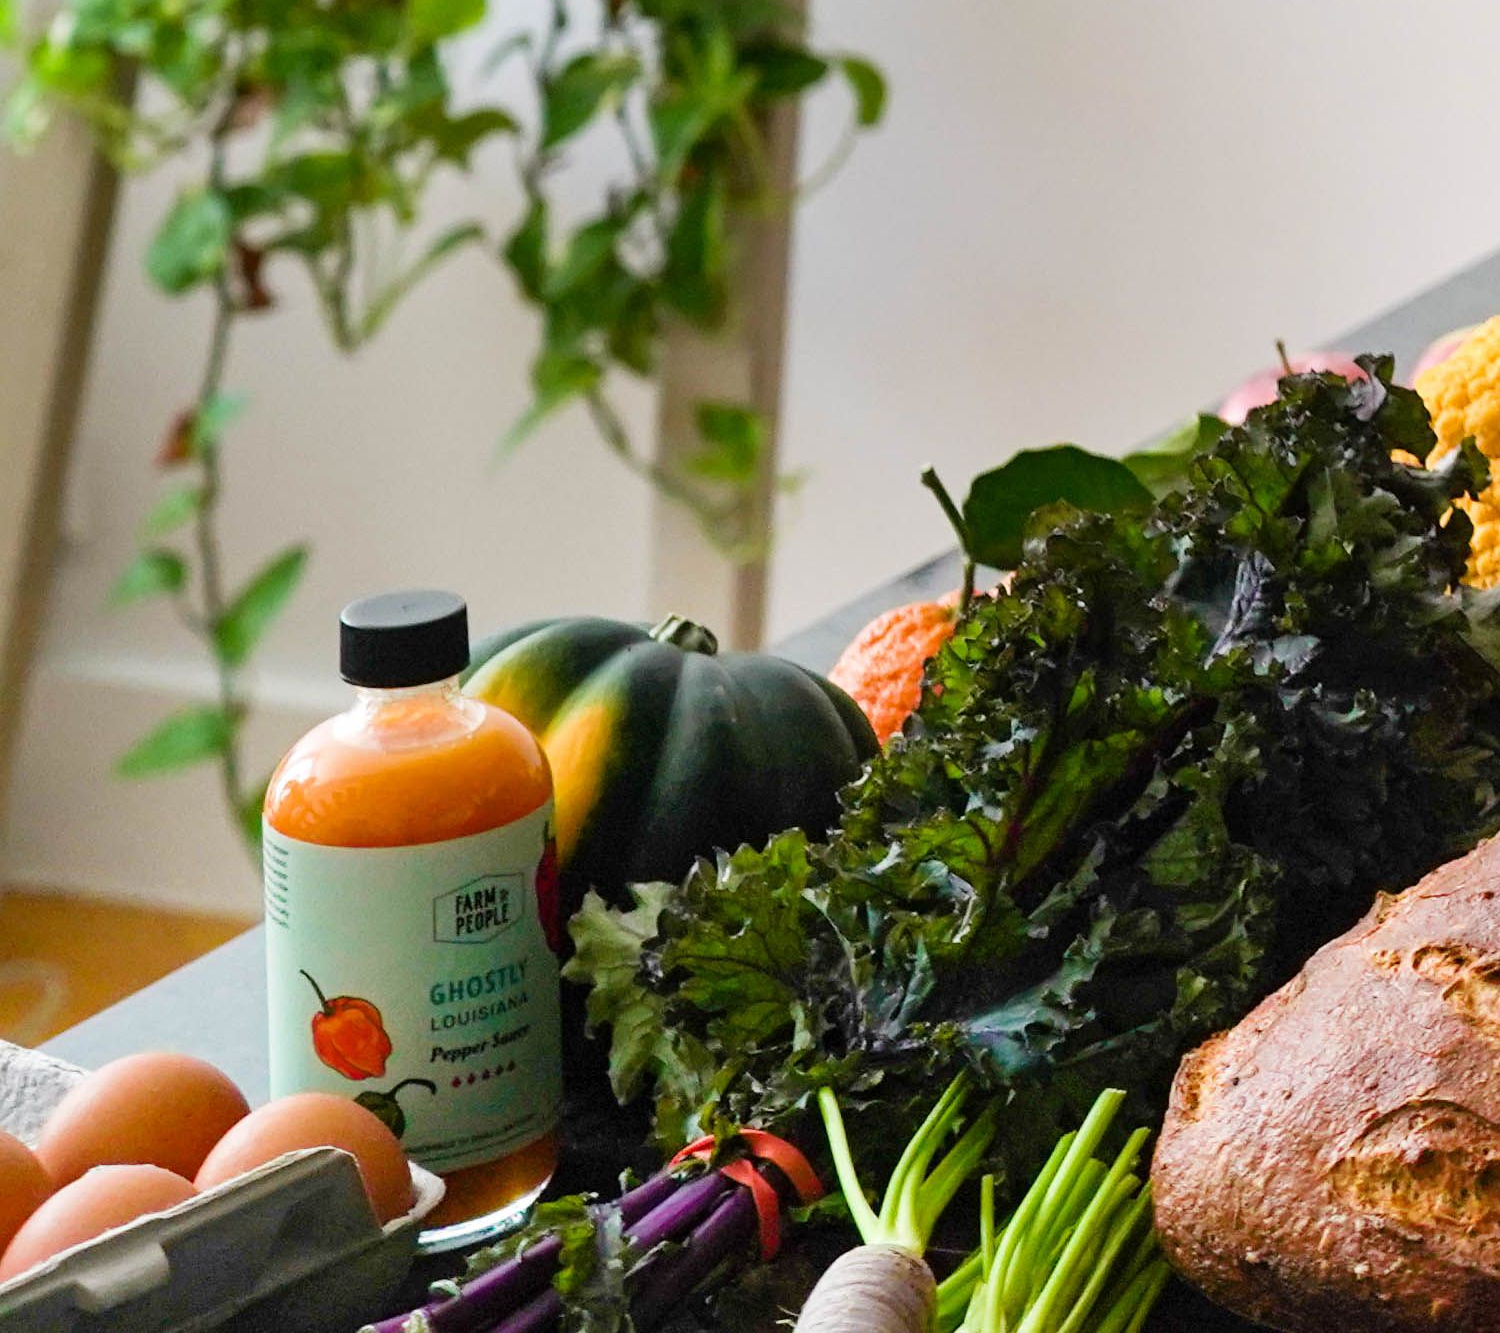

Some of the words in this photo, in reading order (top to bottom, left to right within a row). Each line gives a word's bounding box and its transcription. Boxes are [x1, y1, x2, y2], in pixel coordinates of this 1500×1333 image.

[455, 886, 497, 915] FARM
[455, 902, 510, 937] PEOPLE
[430, 955, 529, 1006] GHOSTLY
[430, 990, 529, 1031] LOUISIANA
[429, 1046, 490, 1064] Pepper
